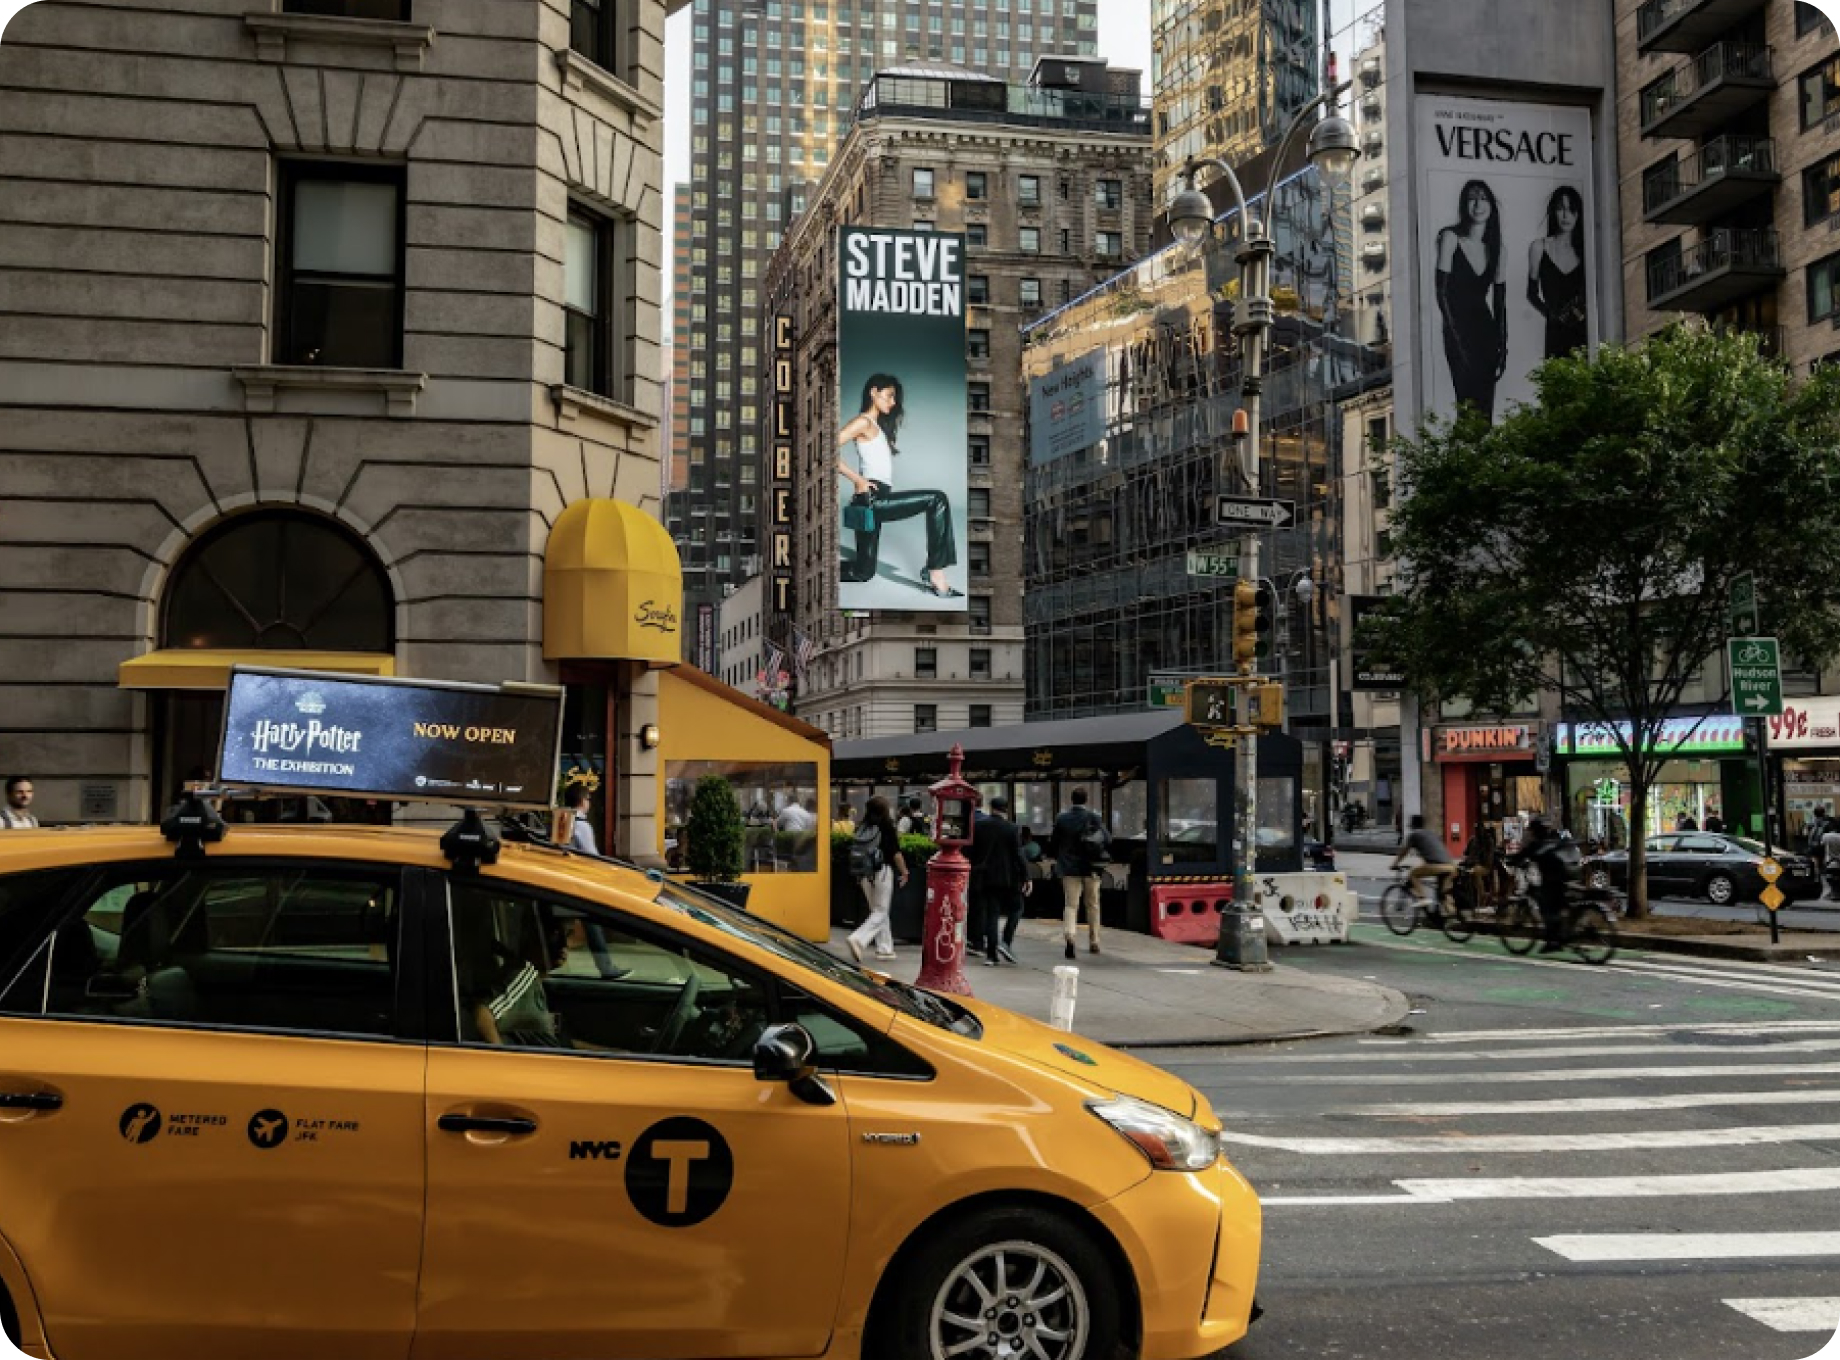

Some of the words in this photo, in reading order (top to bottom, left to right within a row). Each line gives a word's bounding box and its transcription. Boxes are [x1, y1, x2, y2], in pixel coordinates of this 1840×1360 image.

[1434, 124, 1574, 166] VERSACE
[846, 233, 960, 281] STEVE
[846, 278, 961, 316] MADDEN
[776, 317, 790, 610] COLBERT
[1228, 504, 1250, 517] ONE
[1209, 555, 1228, 577] 55
[1733, 667, 1776, 679] Hudson
[1740, 680, 1772, 691] River
[251, 719, 306, 752] Harry
[306, 719, 362, 755] Potter
[414, 722, 461, 741] NOW
[464, 726, 516, 745] OPEN
[253, 757, 279, 771] THE
[280, 759, 355, 776] EXHIBITION
[169, 1114, 227, 1126] METERED
[296, 1118, 326, 1130] FLAT
[328, 1120, 359, 1132] FARE
[168, 1126, 200, 1137] FARE
[295, 1131, 318, 1142] JFK
[568, 1141, 622, 1160] NYC
[651, 1139, 710, 1214] T
